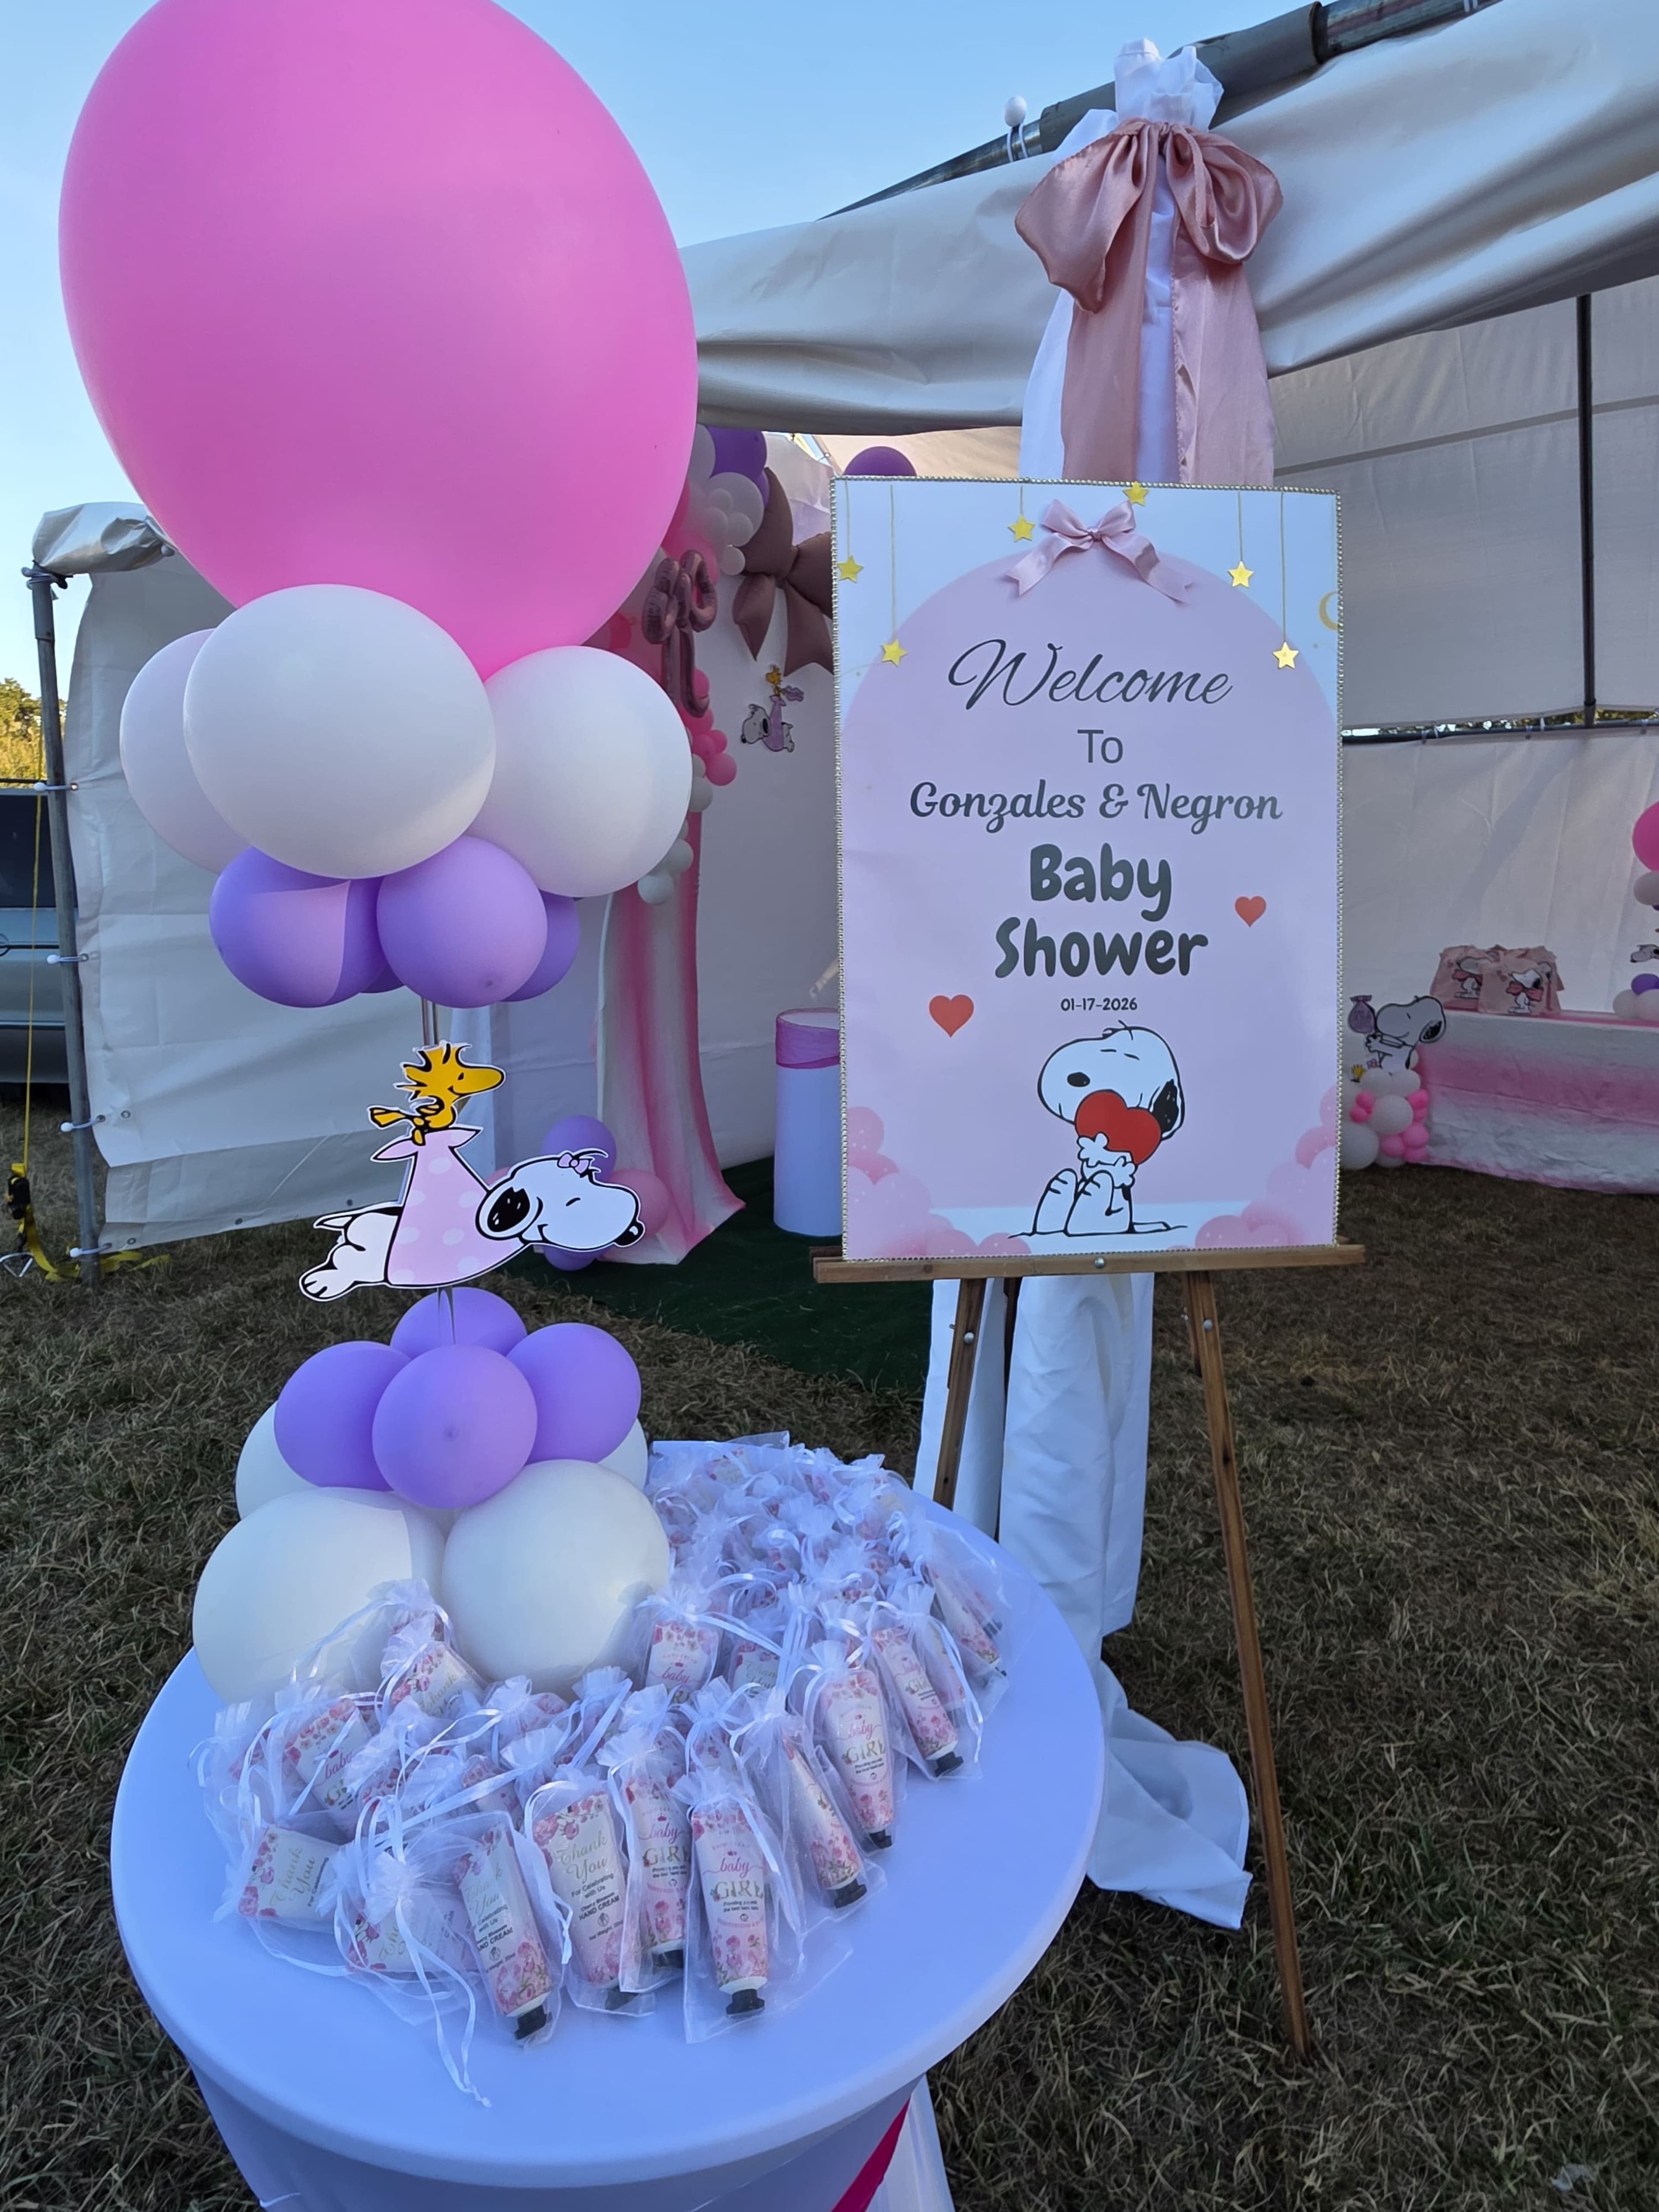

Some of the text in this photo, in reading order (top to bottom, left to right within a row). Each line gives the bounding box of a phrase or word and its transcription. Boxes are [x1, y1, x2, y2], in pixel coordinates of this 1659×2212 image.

[947, 638, 1233, 710] Welcome
[1077, 729, 1124, 764] To
[910, 779, 1283, 835] Gonzales & Negron
[1029, 842, 1172, 922] Baby
[995, 917, 1209, 979] Shower
[1060, 997, 1138, 1011] 01-17-2026
[644, 1822, 681, 1844] baby
[554, 1830, 607, 1865] Thank
[289, 1857, 315, 1901] You
[566, 1858, 607, 1884] You
[713, 1857, 756, 1879] baby
[583, 1873, 614, 1891] Celebrating
[713, 1880, 763, 1900] GIRL
[579, 1895, 620, 1921] HAND CREAM
[490, 1927, 513, 1944] CREAM
